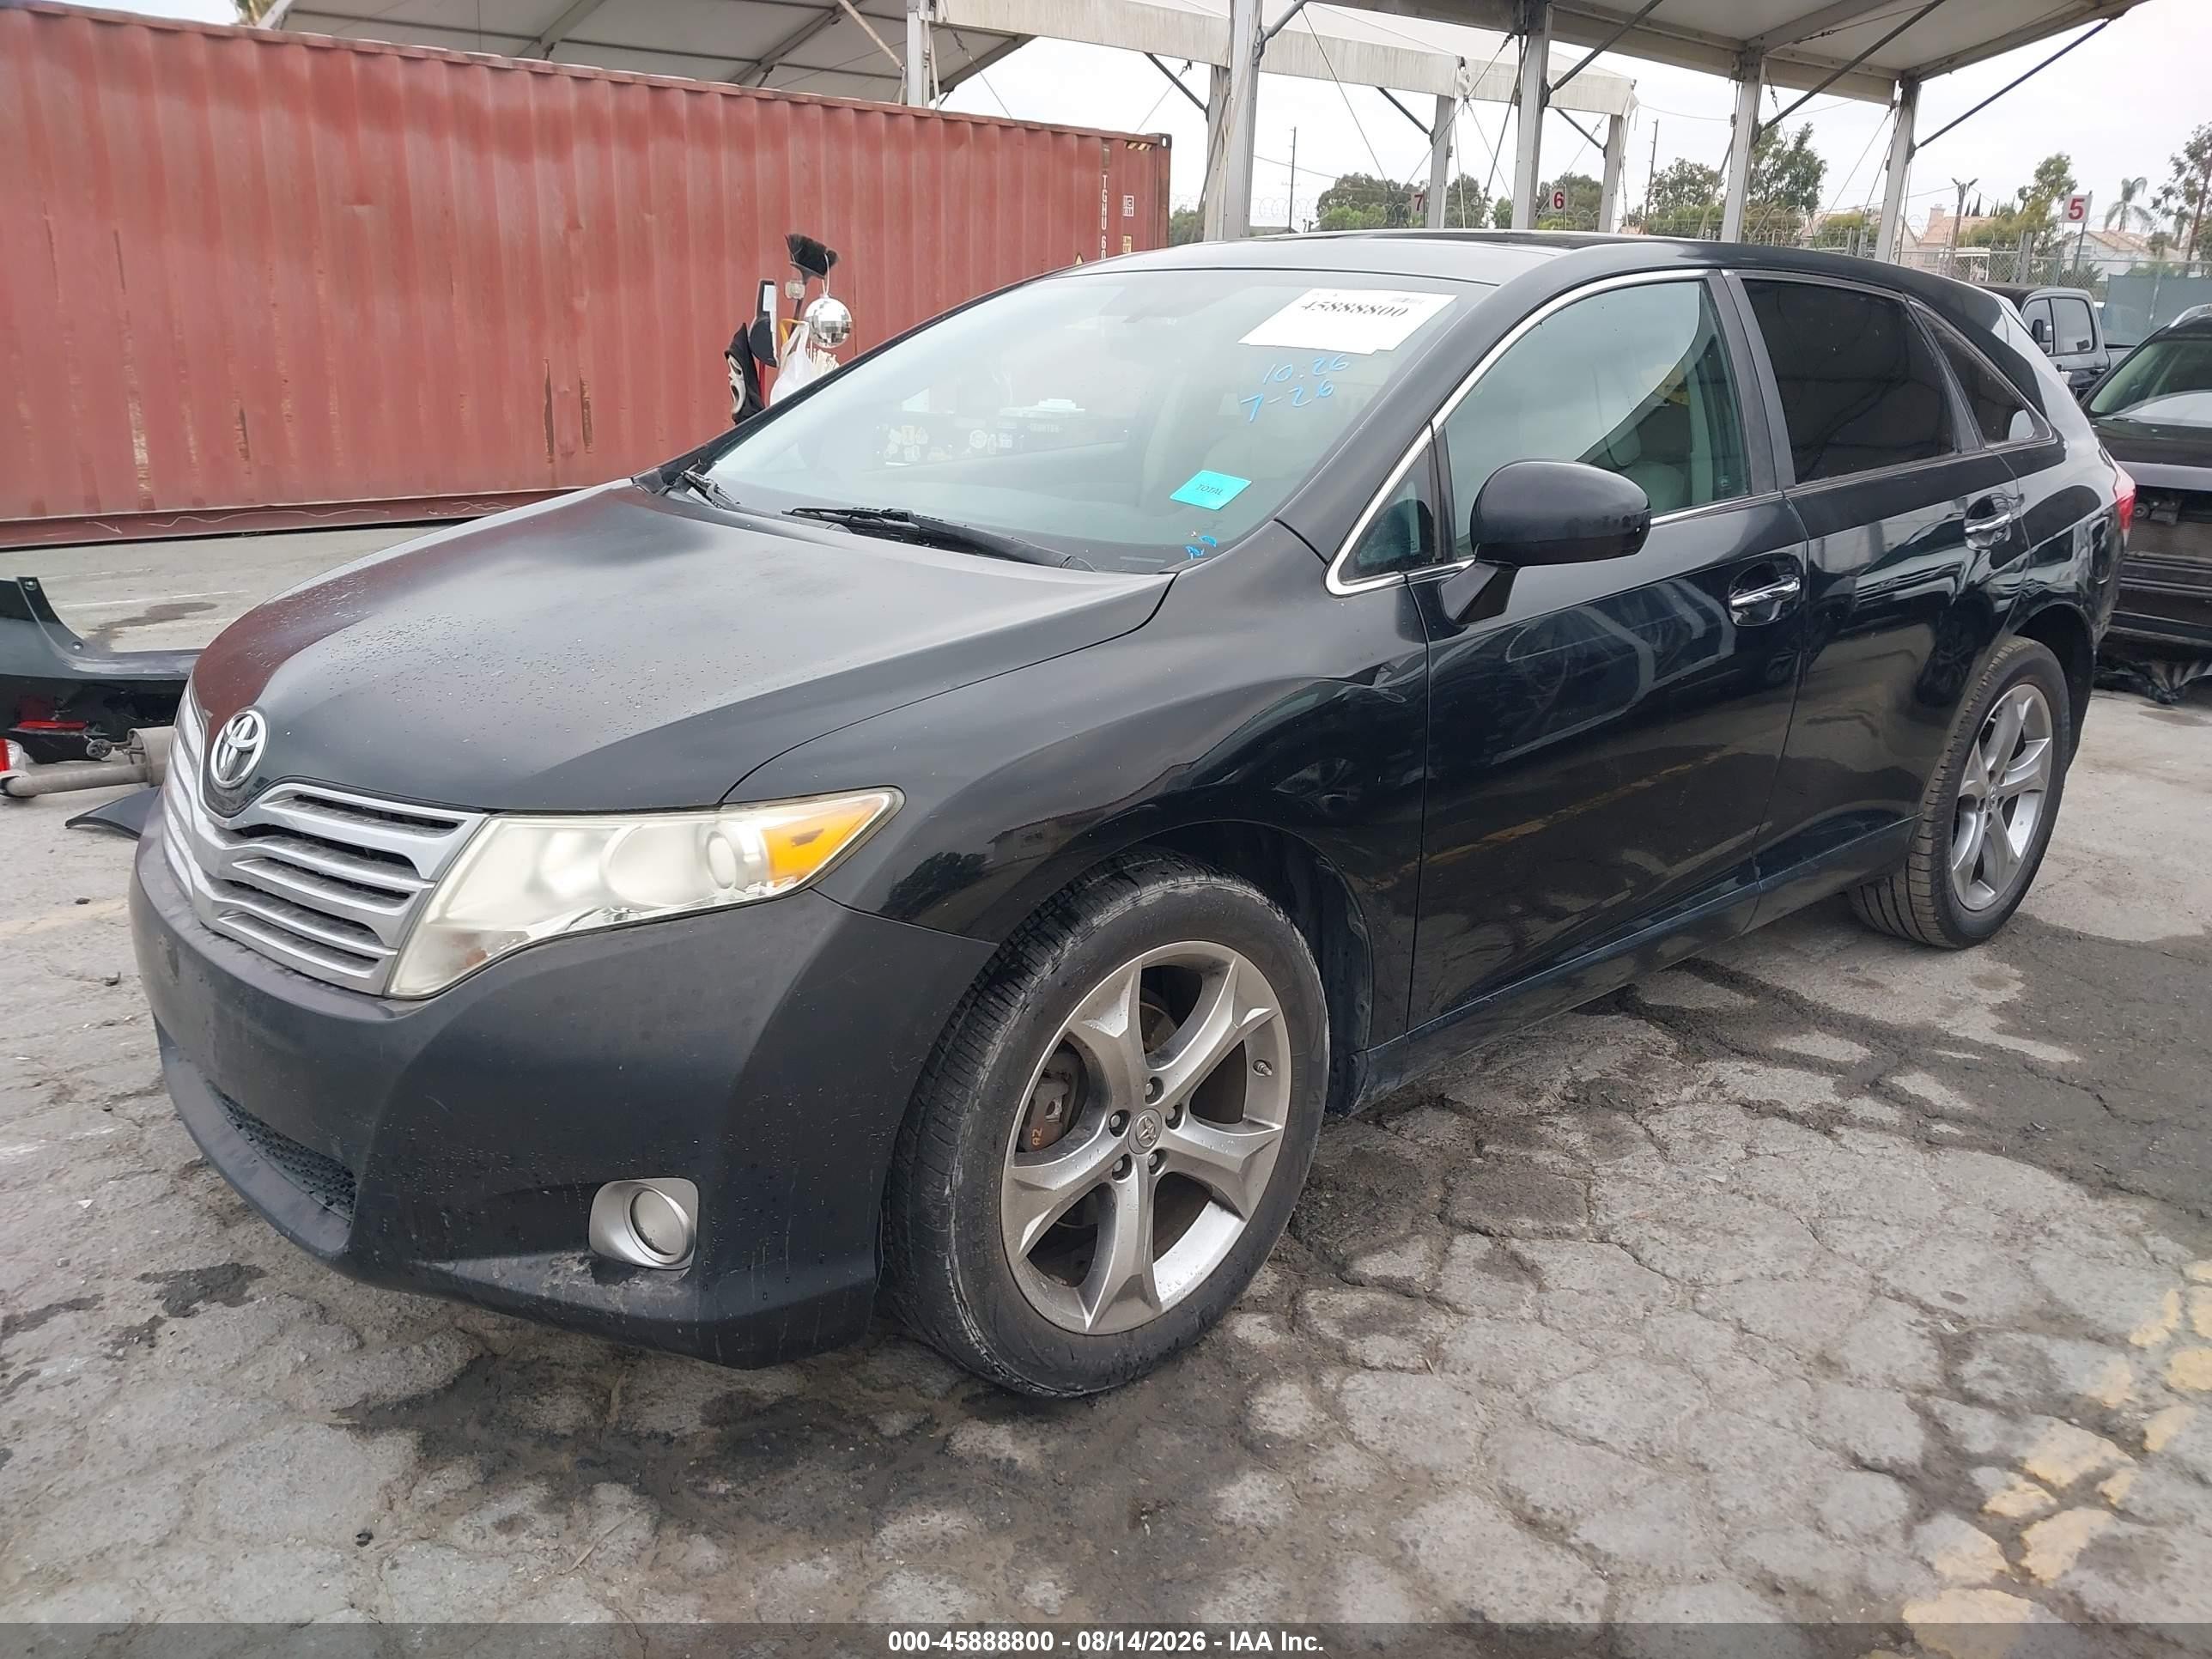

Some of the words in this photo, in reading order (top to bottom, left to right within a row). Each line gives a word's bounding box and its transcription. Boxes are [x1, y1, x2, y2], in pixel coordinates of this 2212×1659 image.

[1414, 194, 1423, 211] 7
[1553, 191, 1564, 210] 6
[2068, 198, 2085, 220] 5
[1195, 483, 1224, 495] TOTAL
